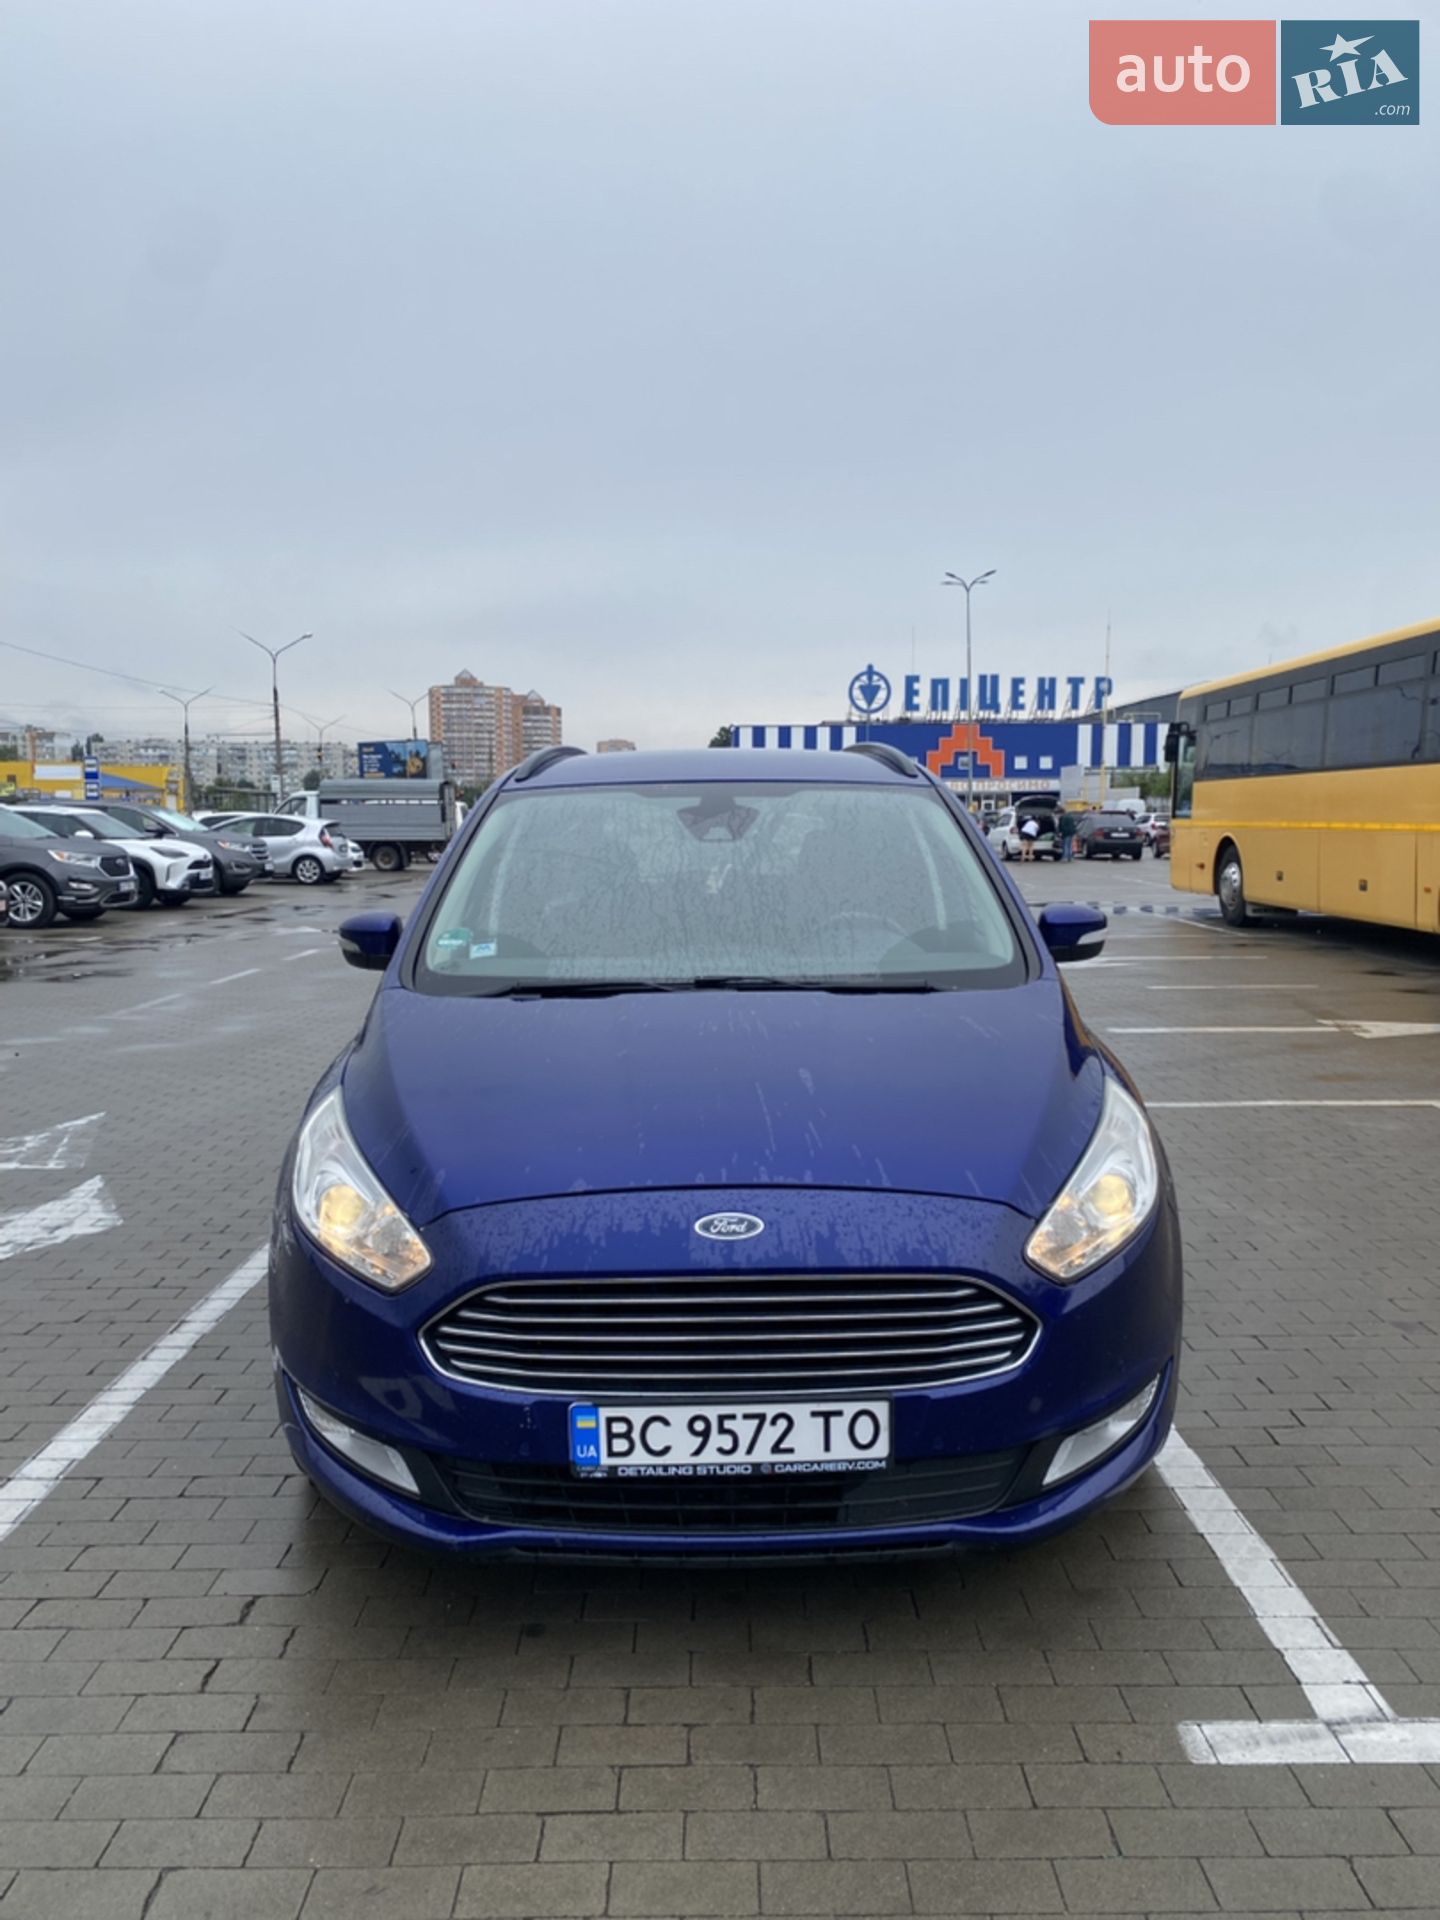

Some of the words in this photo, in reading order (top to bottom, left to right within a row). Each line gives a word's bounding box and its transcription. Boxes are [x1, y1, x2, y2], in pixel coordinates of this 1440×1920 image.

[904, 673, 1114, 714] ЕПІЦЕНТР
[709, 1217, 748, 1233] Ford
[604, 1414, 673, 1458] BC
[686, 1411, 796, 1457] 9572
[809, 1408, 881, 1453] TO
[576, 1444, 598, 1459] UA
[617, 1464, 694, 1477] DETAILING
[696, 1463, 753, 1475] STUDIO
